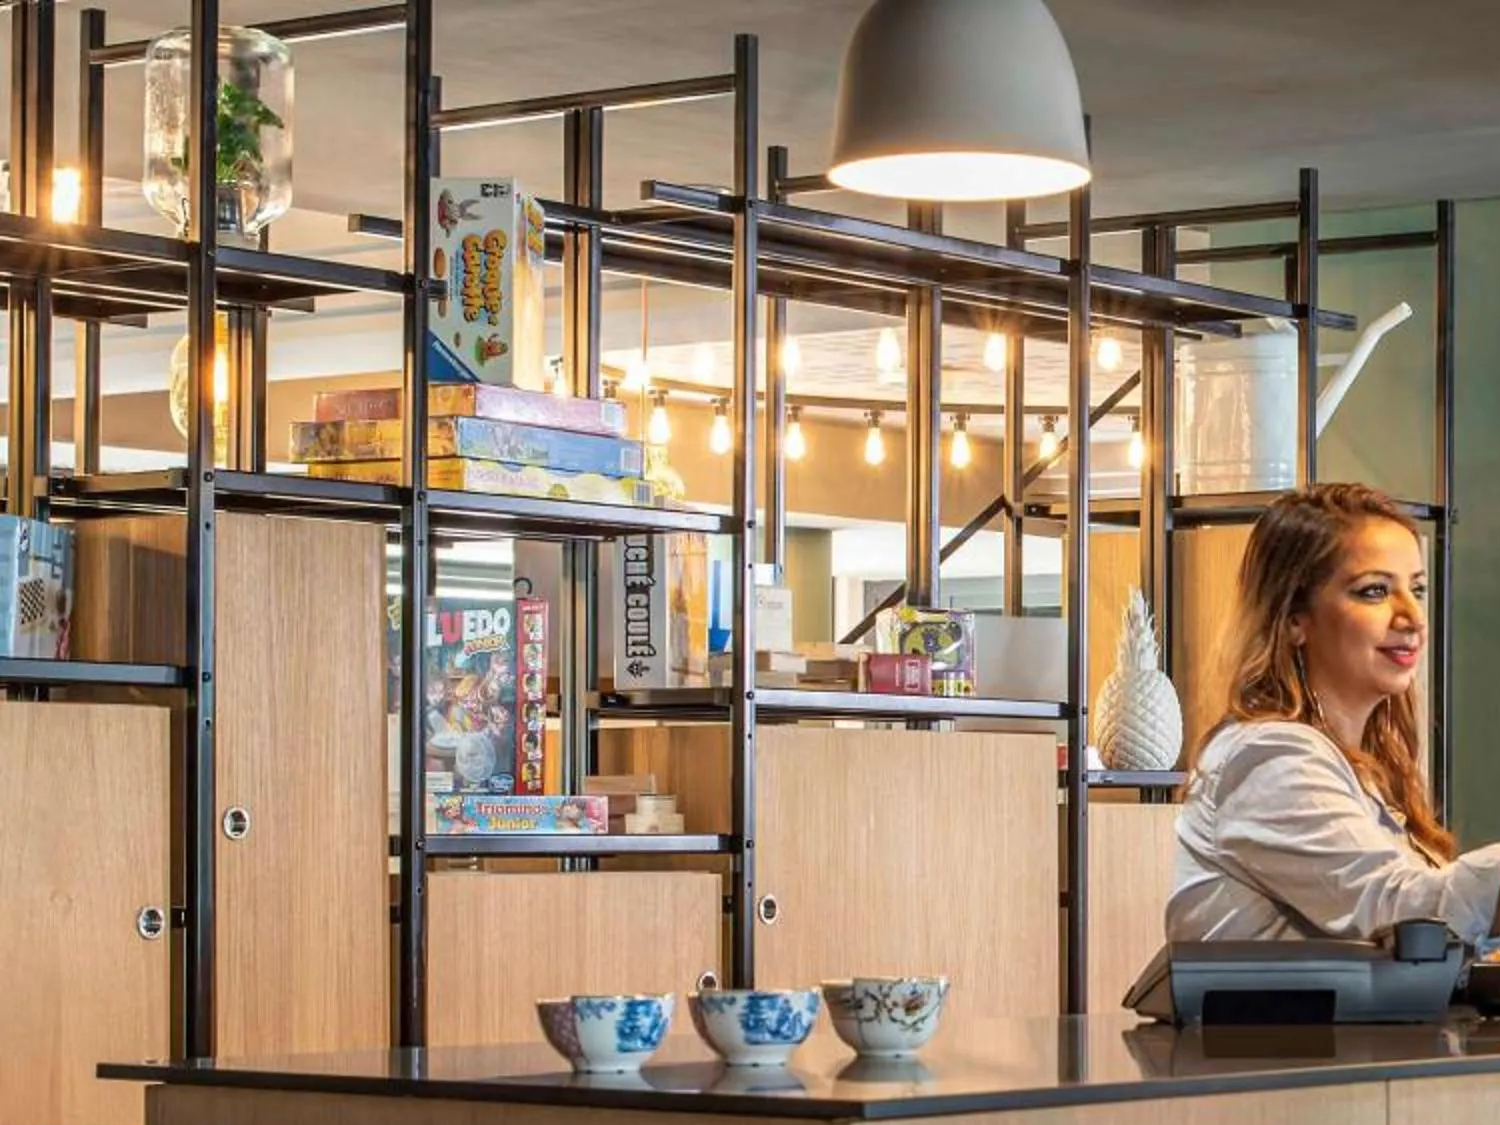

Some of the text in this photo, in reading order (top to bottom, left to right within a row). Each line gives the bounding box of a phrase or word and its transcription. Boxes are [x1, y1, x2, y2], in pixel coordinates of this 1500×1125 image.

[426, 607, 511, 647] LUEDO
[624, 535, 656, 658] UCHÉ COULÉ
